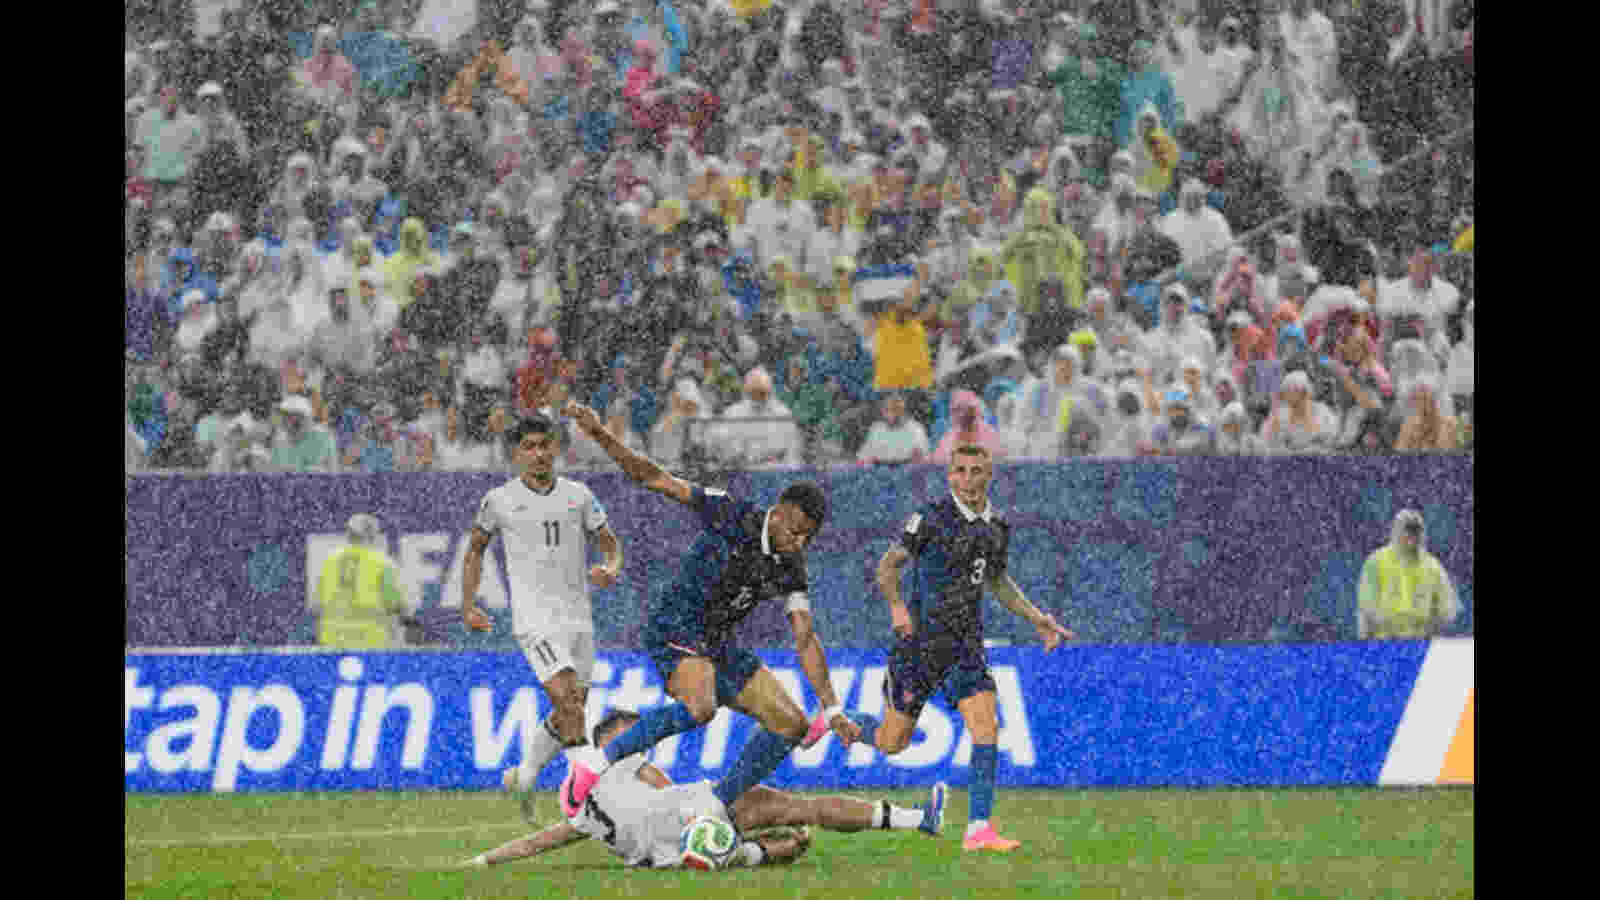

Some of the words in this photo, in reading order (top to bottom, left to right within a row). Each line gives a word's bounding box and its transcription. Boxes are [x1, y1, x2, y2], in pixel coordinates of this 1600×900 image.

[542, 519, 560, 547] 11
[970, 557, 987, 585] 3
[535, 639, 558, 667] 11
[319, 656, 435, 769] in
